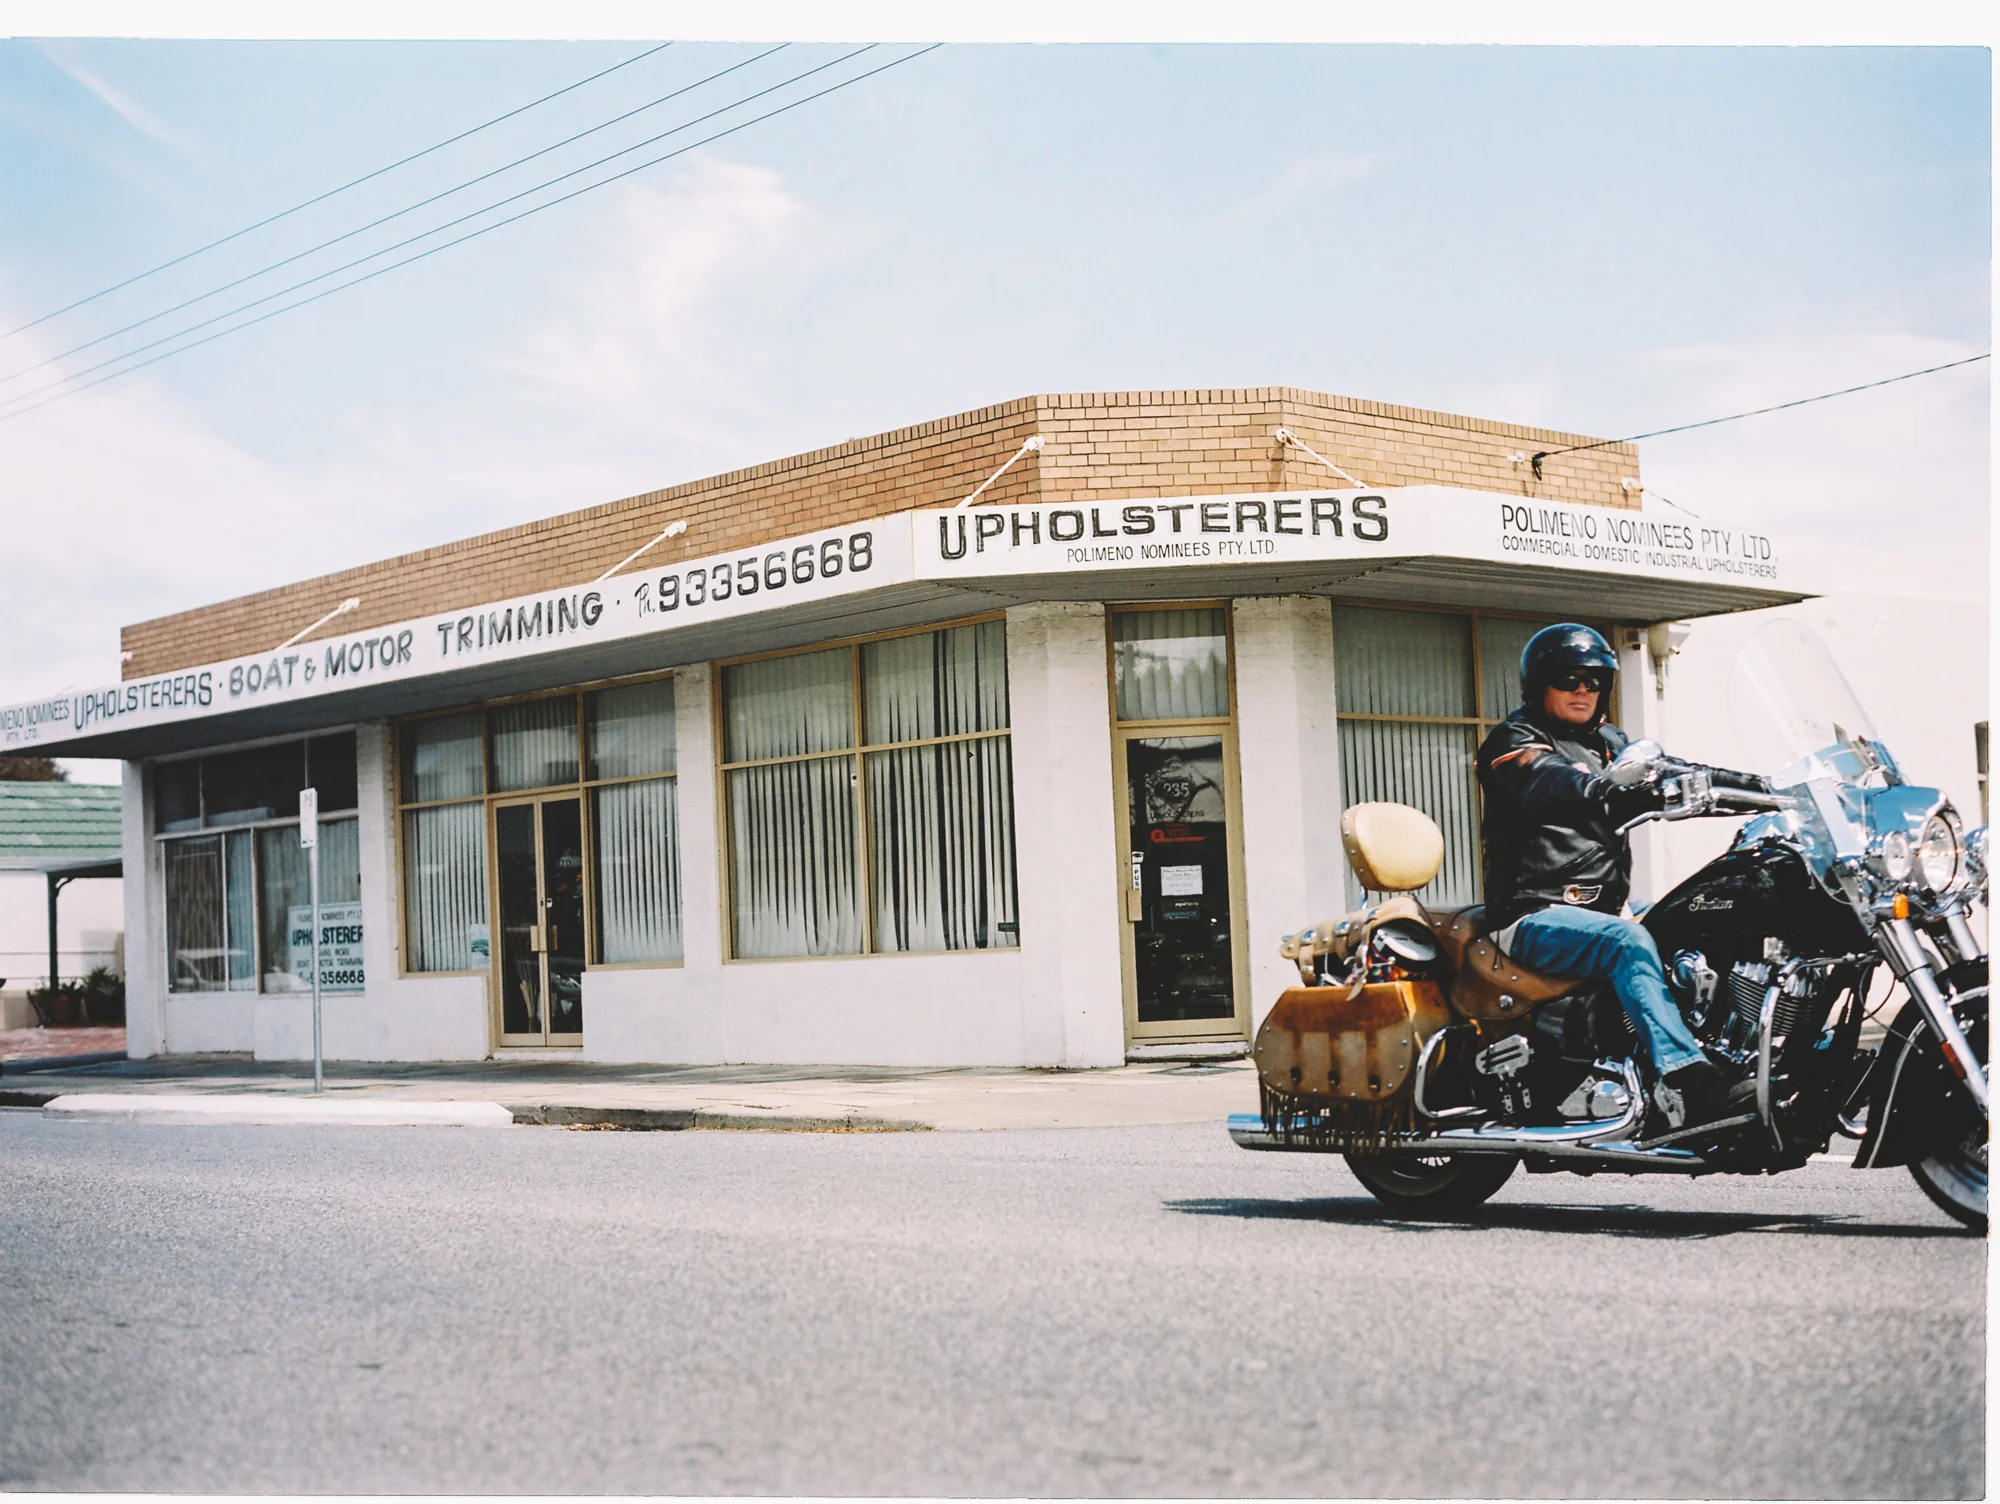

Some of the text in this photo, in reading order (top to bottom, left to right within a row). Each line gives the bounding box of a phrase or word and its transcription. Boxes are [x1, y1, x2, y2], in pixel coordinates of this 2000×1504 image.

[939, 495, 1388, 560] UPHOLSTERERS
[1502, 503, 1597, 539] POLIMENO
[1606, 517, 1694, 550] NOMINEES
[1067, 545, 1134, 563] POLIMENO
[1141, 541, 1210, 560] NOMINEES
[1502, 535, 1777, 579] COMMERCIAL DOMESTIC INDUSTRIAL UPHOLSTERERS
[74, 671, 213, 730] UPHOLSTERERS
[229, 654, 299, 696] BOAT
[304, 657, 316, 682] &
[324, 629, 414, 679] MOTOR
[437, 591, 603, 656] TRIMMING
[26, 699, 70, 726] NOMINEES
